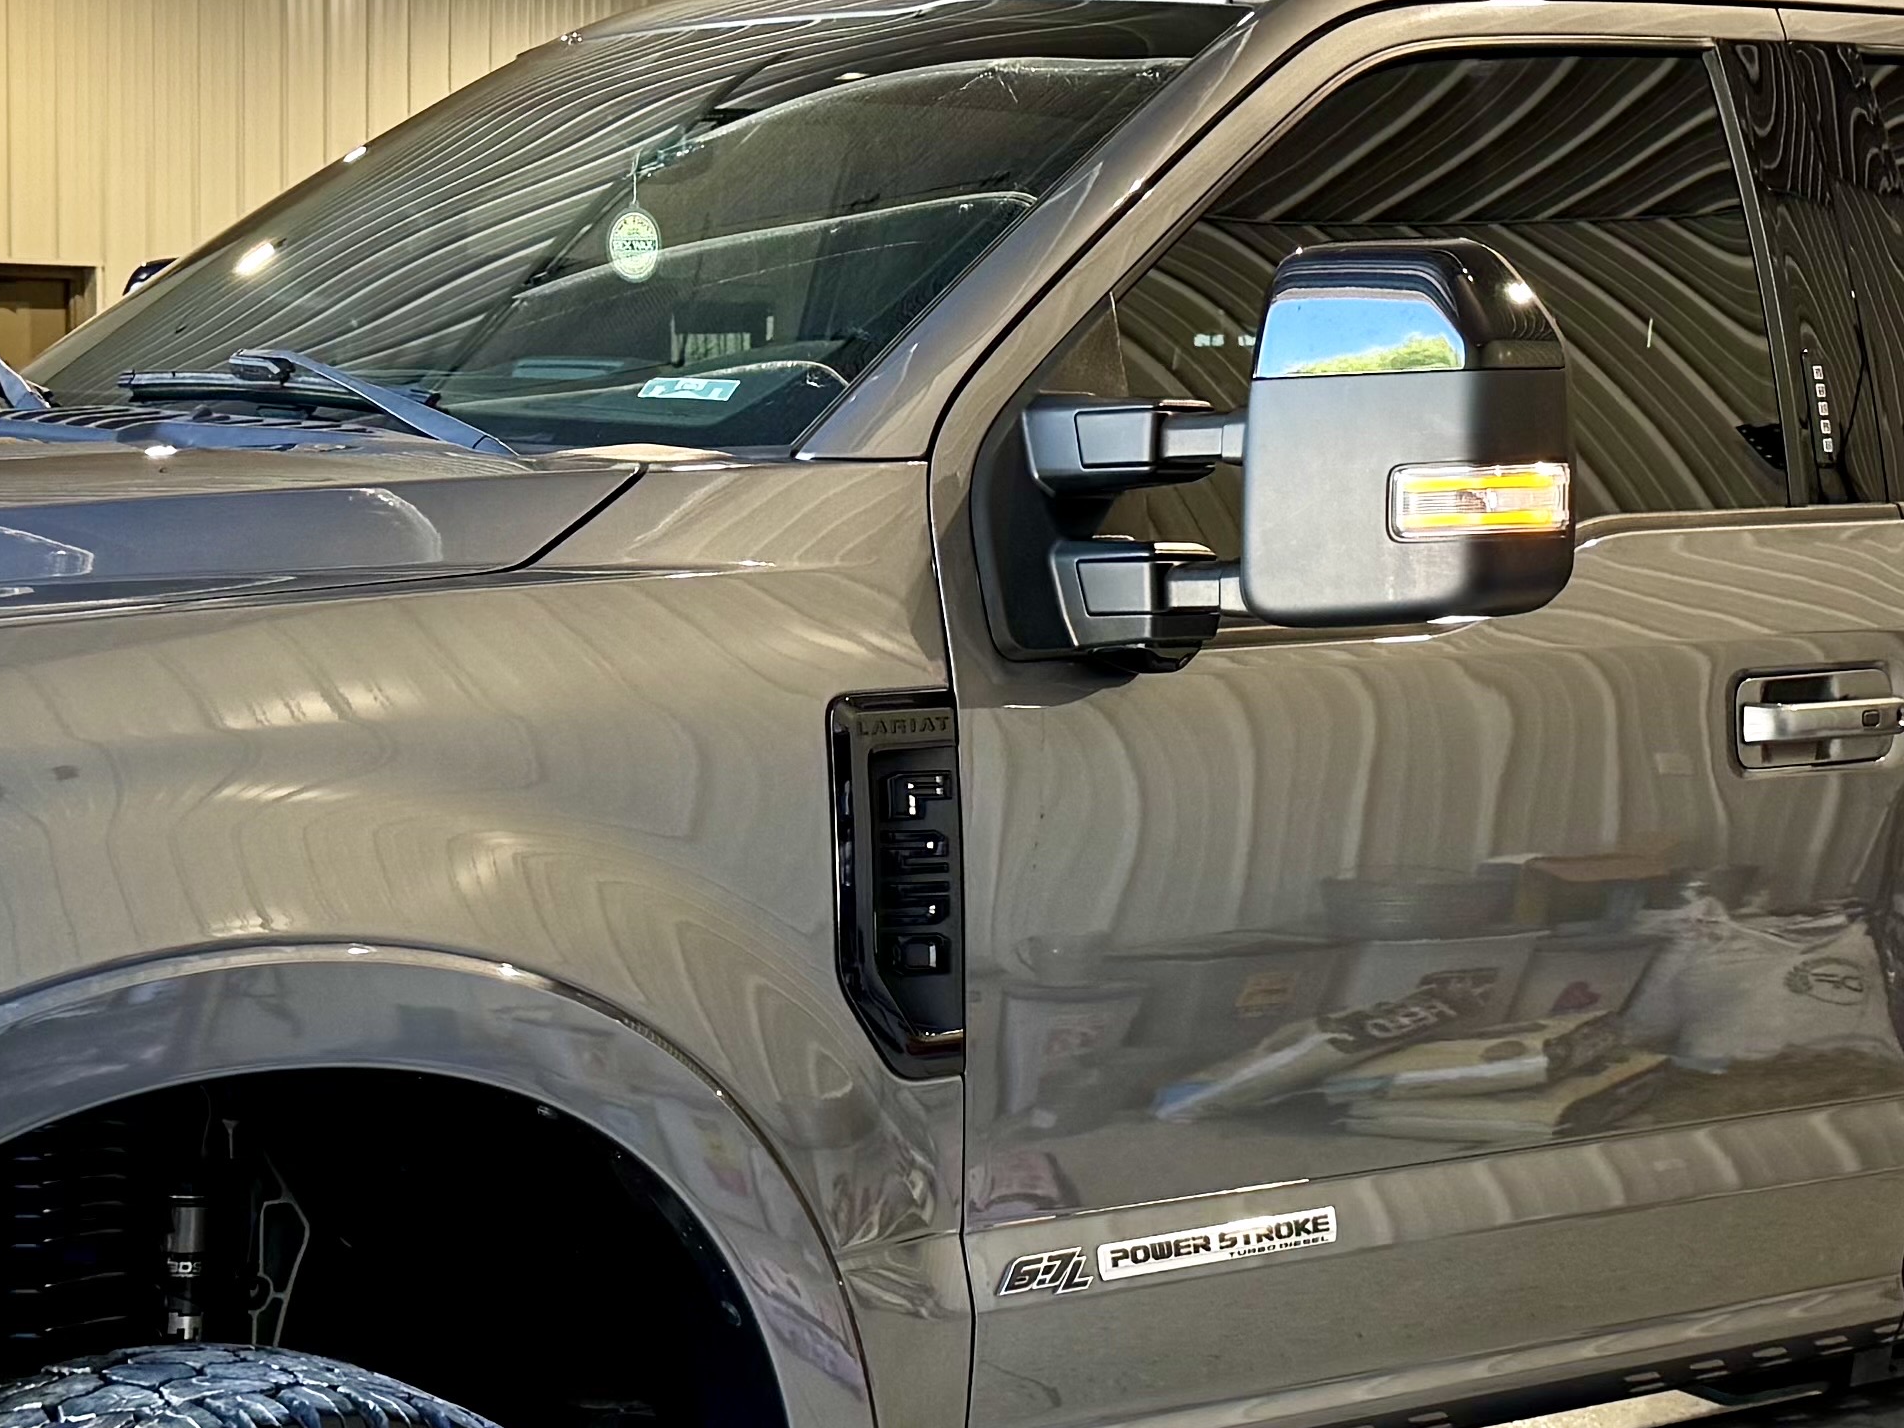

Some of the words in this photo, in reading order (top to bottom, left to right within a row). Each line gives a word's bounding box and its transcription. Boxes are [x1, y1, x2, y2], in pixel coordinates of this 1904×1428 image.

[855, 715, 950, 737] LARIAT
[1109, 1234, 1212, 1268] POWER
[1218, 1213, 1331, 1250] STROKE
[1228, 1244, 1276, 1258] TURBO
[1279, 1235, 1329, 1249] DIESEL
